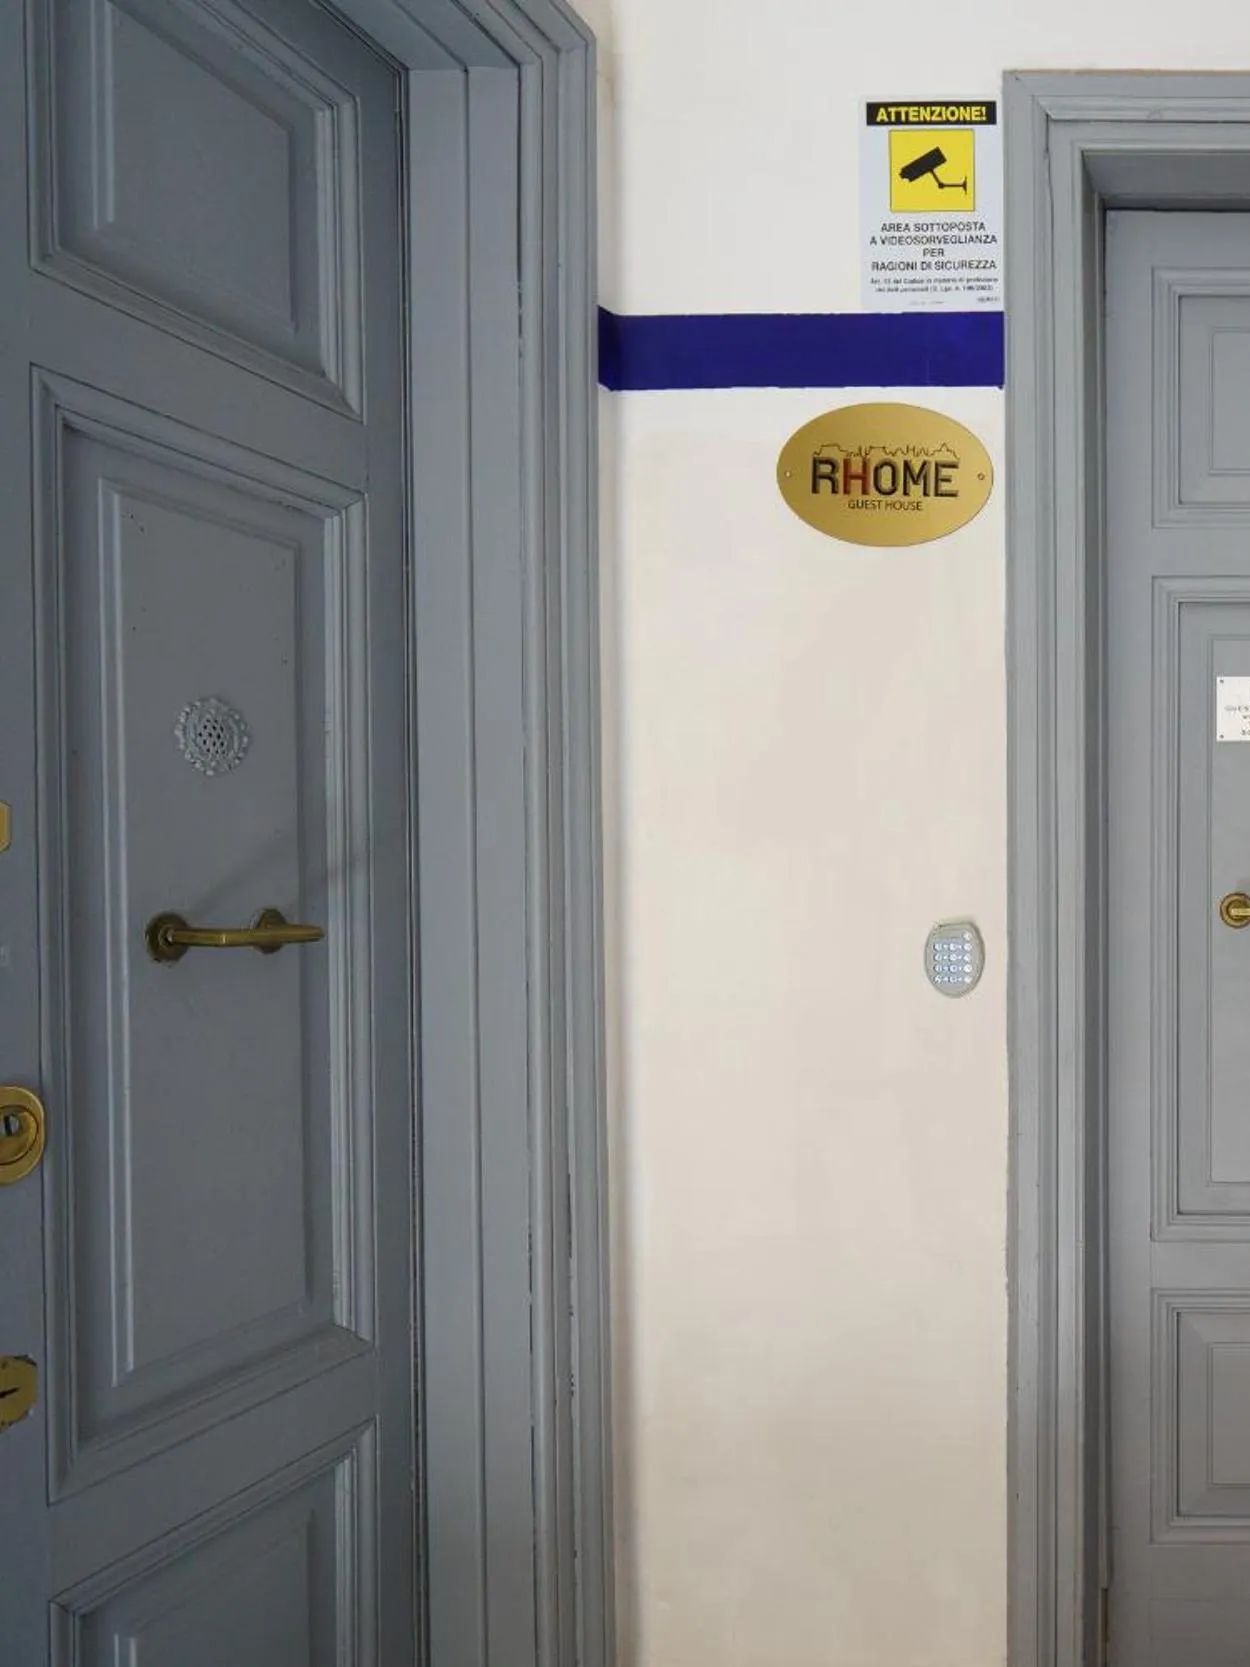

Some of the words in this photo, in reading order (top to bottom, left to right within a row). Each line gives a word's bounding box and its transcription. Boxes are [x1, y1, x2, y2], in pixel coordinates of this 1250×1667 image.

[876, 106, 987, 122] ATTENZIONE!
[881, 223, 911, 232] AREA
[914, 221, 986, 232] SOTTOPOSTA
[870, 236, 877, 245] A
[880, 235, 997, 246] VIDEOSORVEGLIANZA
[923, 248, 945, 257] PER
[871, 261, 918, 271] RAGIONI
[921, 261, 933, 271] DI
[935, 260, 997, 271] SICUREZZA
[811, 457, 960, 498] RHOME
[848, 500, 883, 510] GUEST
[885, 500, 923, 511] HOUSE
